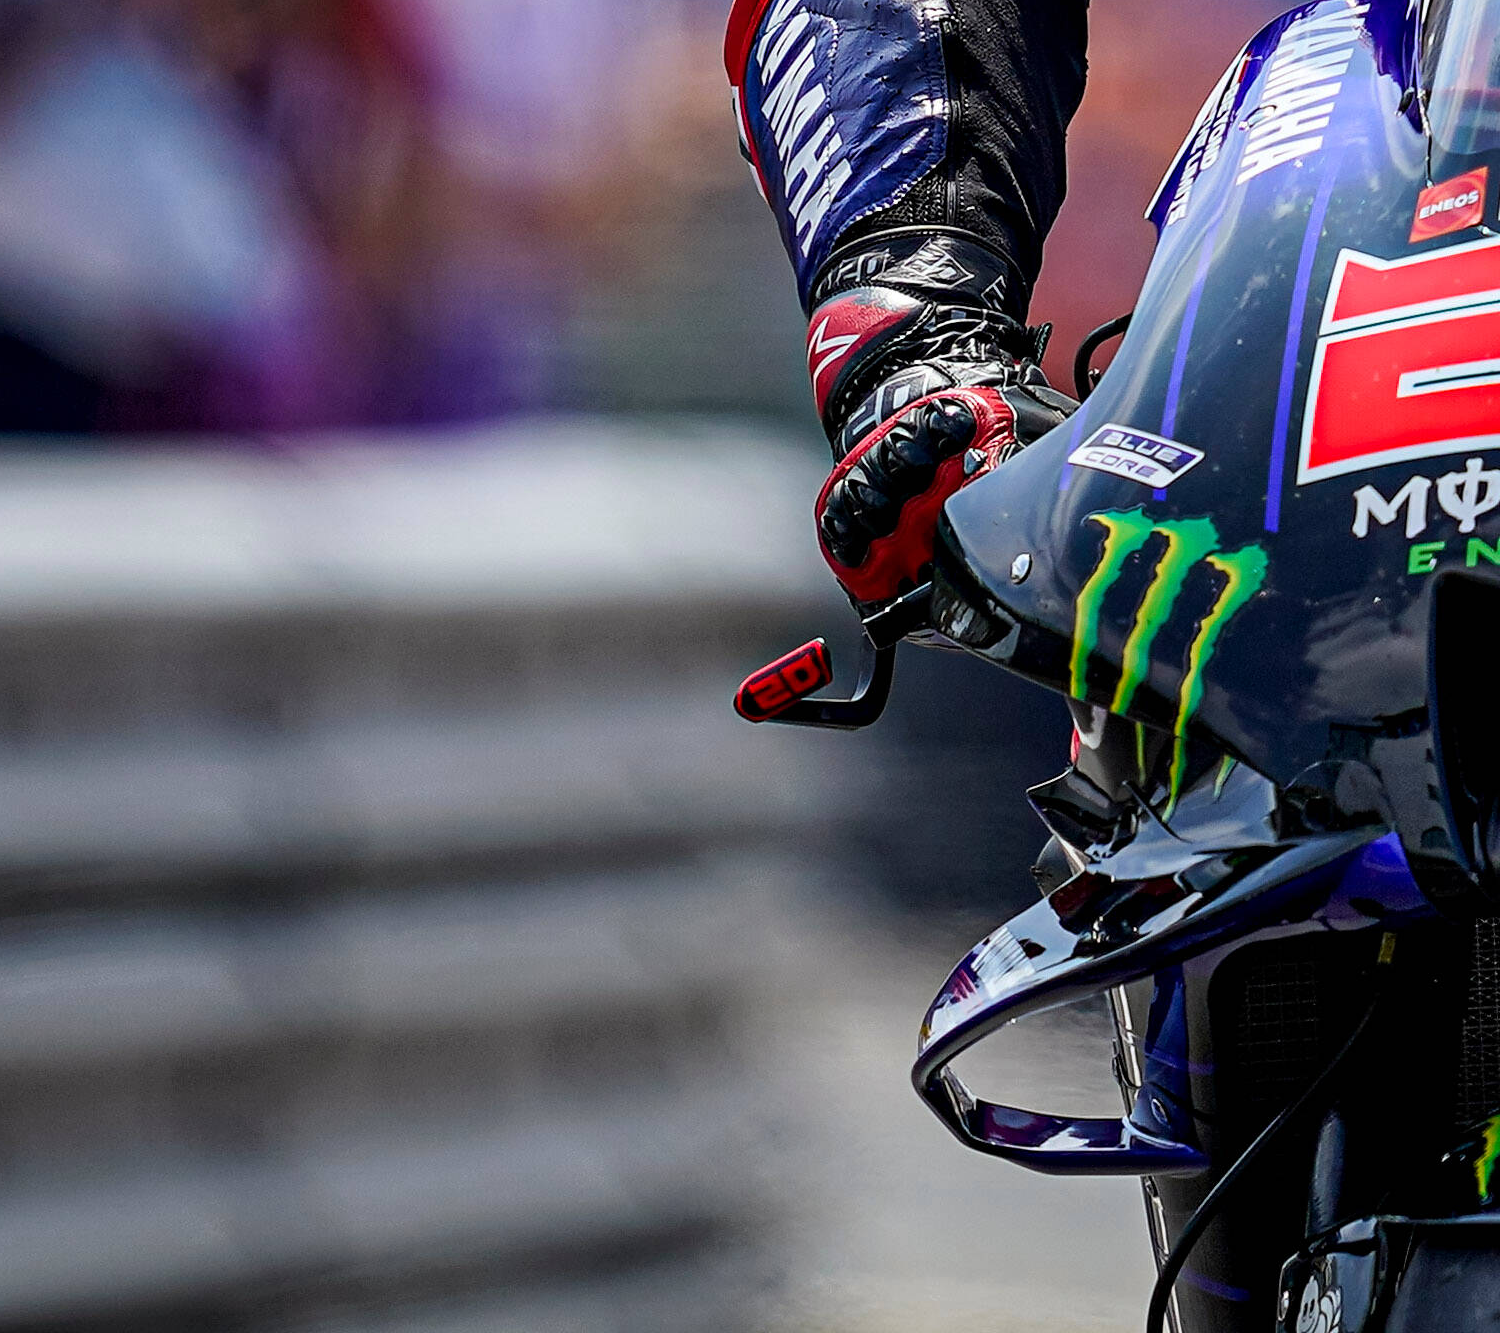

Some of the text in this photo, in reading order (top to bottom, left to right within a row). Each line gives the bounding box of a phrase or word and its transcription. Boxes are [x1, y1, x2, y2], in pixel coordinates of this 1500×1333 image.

[1235, 2, 1372, 187] YAMAHA
[1419, 189, 1480, 220] ENEOS
[1102, 432, 1182, 464] BLUE
[1084, 450, 1159, 479] CORE
[747, 653, 822, 711] 20
